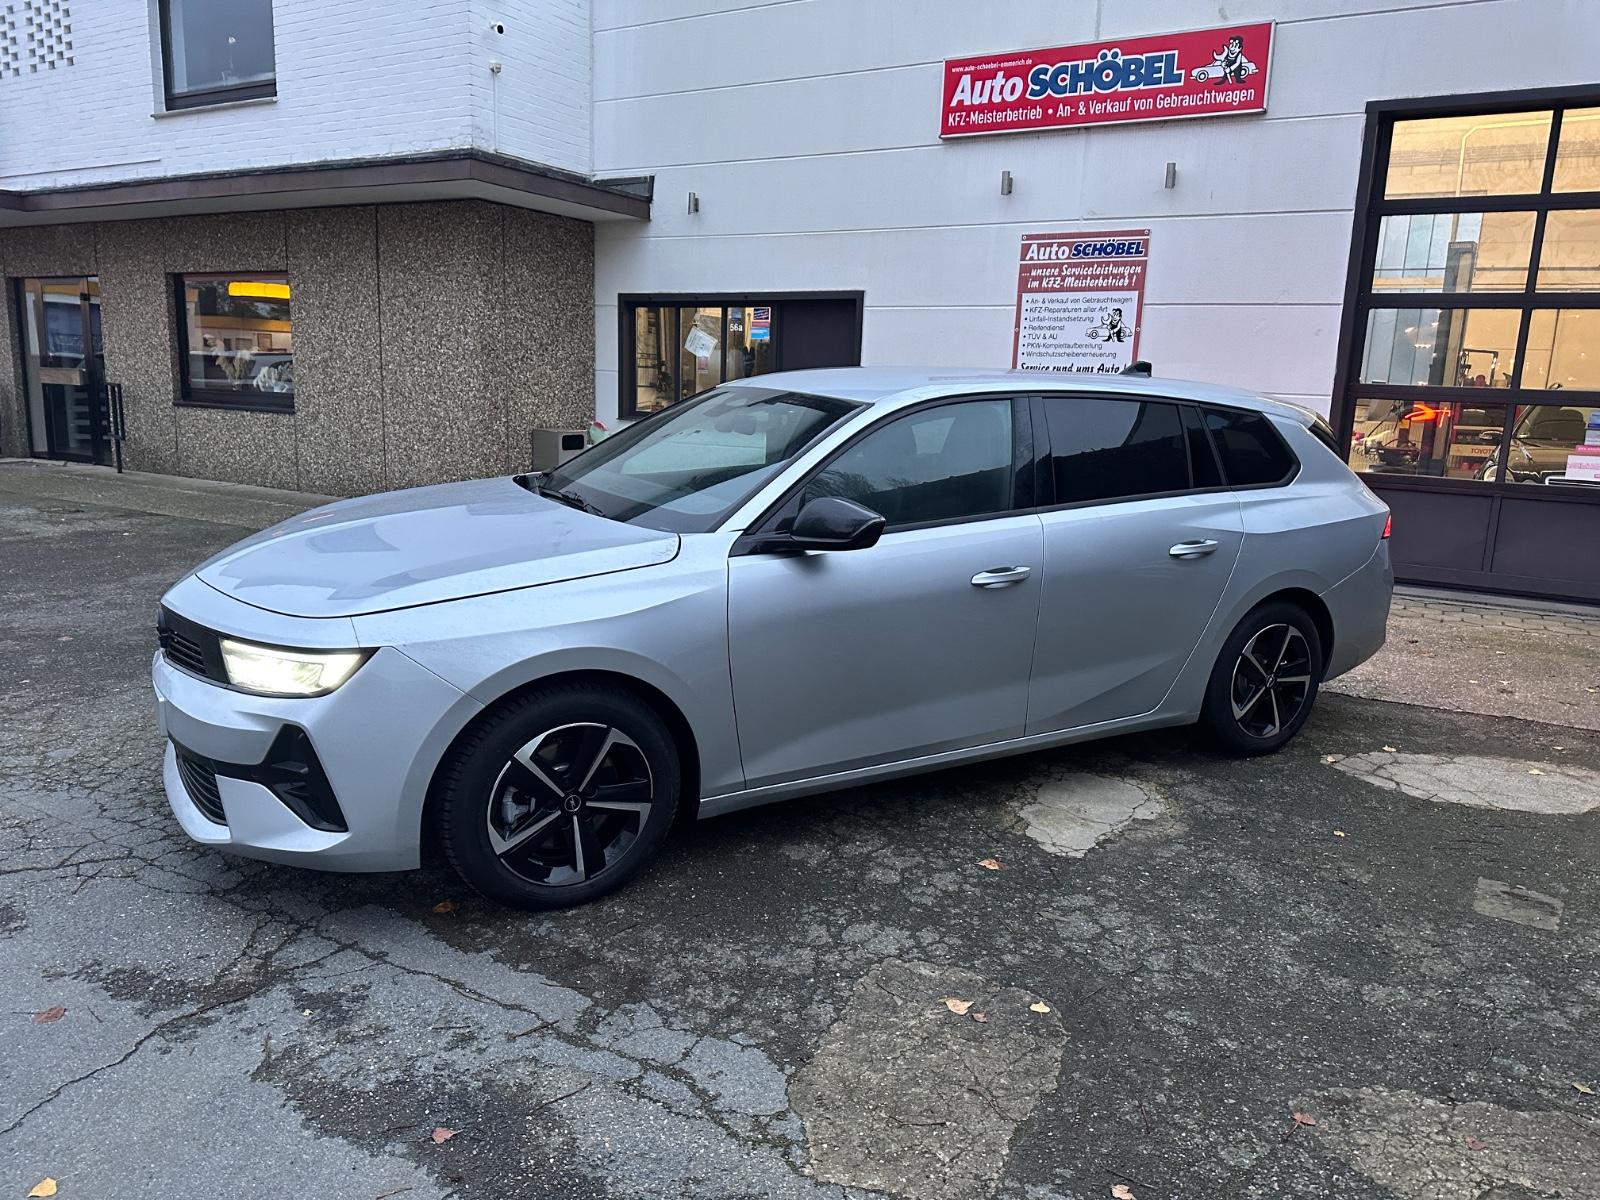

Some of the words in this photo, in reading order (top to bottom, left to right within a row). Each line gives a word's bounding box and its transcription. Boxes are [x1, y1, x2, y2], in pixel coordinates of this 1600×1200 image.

[950, 71, 1024, 107] Auto
[1026, 48, 1185, 100] SCHÖBEL
[948, 105, 1042, 127] KFZ-Meisterbetrieb
[1056, 103, 1075, 117] An-
[1078, 101, 1086, 116] &
[1089, 97, 1132, 114] Verkauf
[1133, 98, 1153, 111] von
[1156, 88, 1255, 109] Gebrauchtwagen
[1025, 243, 1070, 261] Auto
[1070, 238, 1145, 258] SCHÖBEL
[1061, 264, 1142, 276] Serviceleistungen
[1027, 278, 1039, 288] im
[1041, 275, 1129, 288] KFZ-Meisterbetrieb
[1082, 296, 1133, 305] Gebrauchtwagen
[1029, 306, 1082, 314] KFZ-Reparaturen
[1028, 315, 1094, 324] Unfall-Instandsetzung
[1026, 342, 1103, 351] PKW-Komplettaufbereitung
[1025, 350, 1117, 360] Windschutzscheibenerneuerung
[1052, 362, 1074, 373] rund
[1075, 365, 1094, 373] ums
[1096, 363, 1120, 374] Auto
